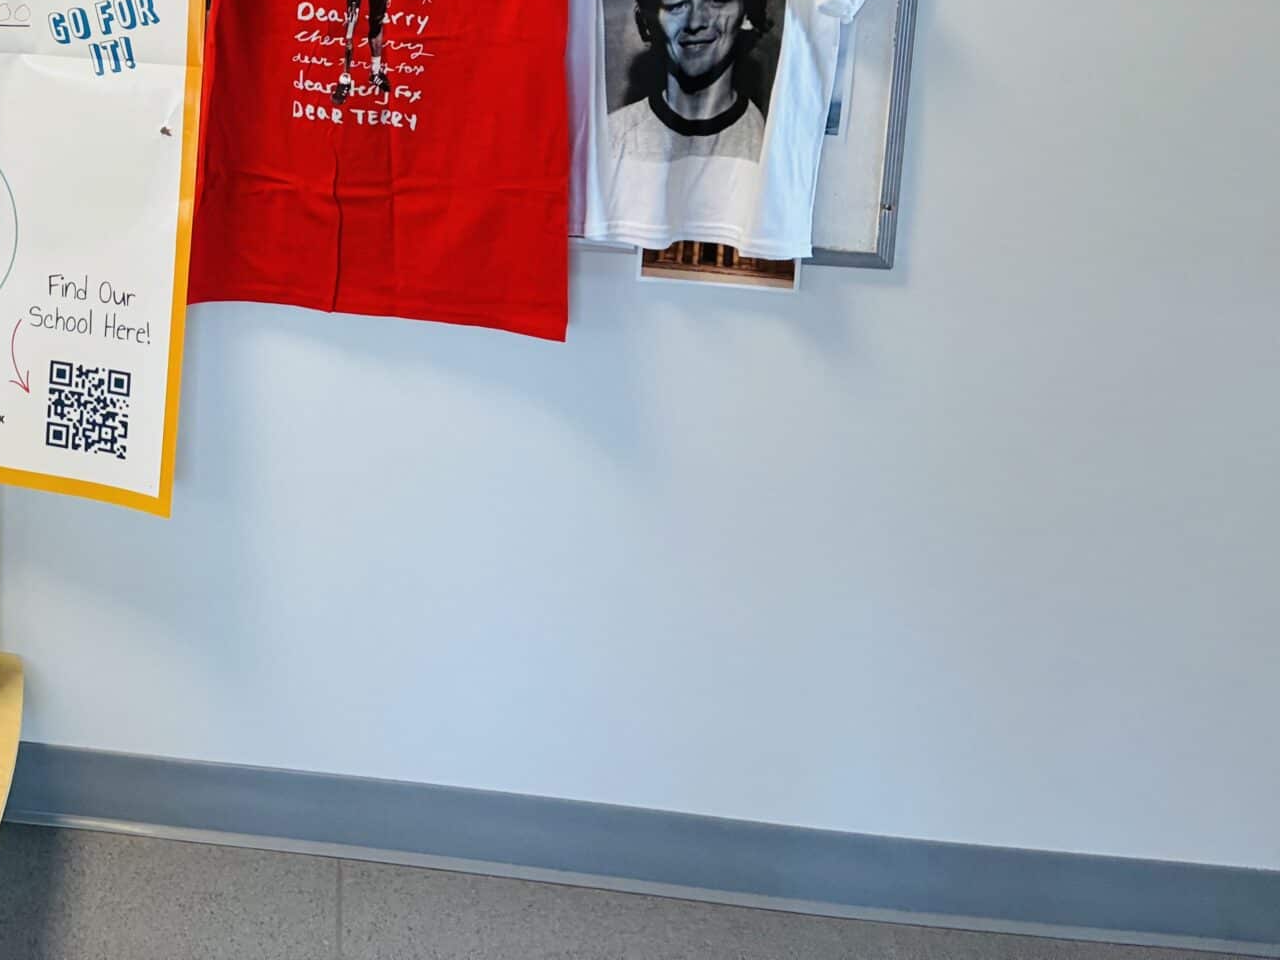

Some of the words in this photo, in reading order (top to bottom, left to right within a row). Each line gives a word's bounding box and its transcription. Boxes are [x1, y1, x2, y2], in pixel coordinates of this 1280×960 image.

[47, 7, 91, 45] GO
[88, 36, 136, 76] IT!
[48, 273, 88, 301] Find
[98, 281, 136, 307] Our
[28, 306, 93, 335] School
[103, 312, 152, 345] Here!
